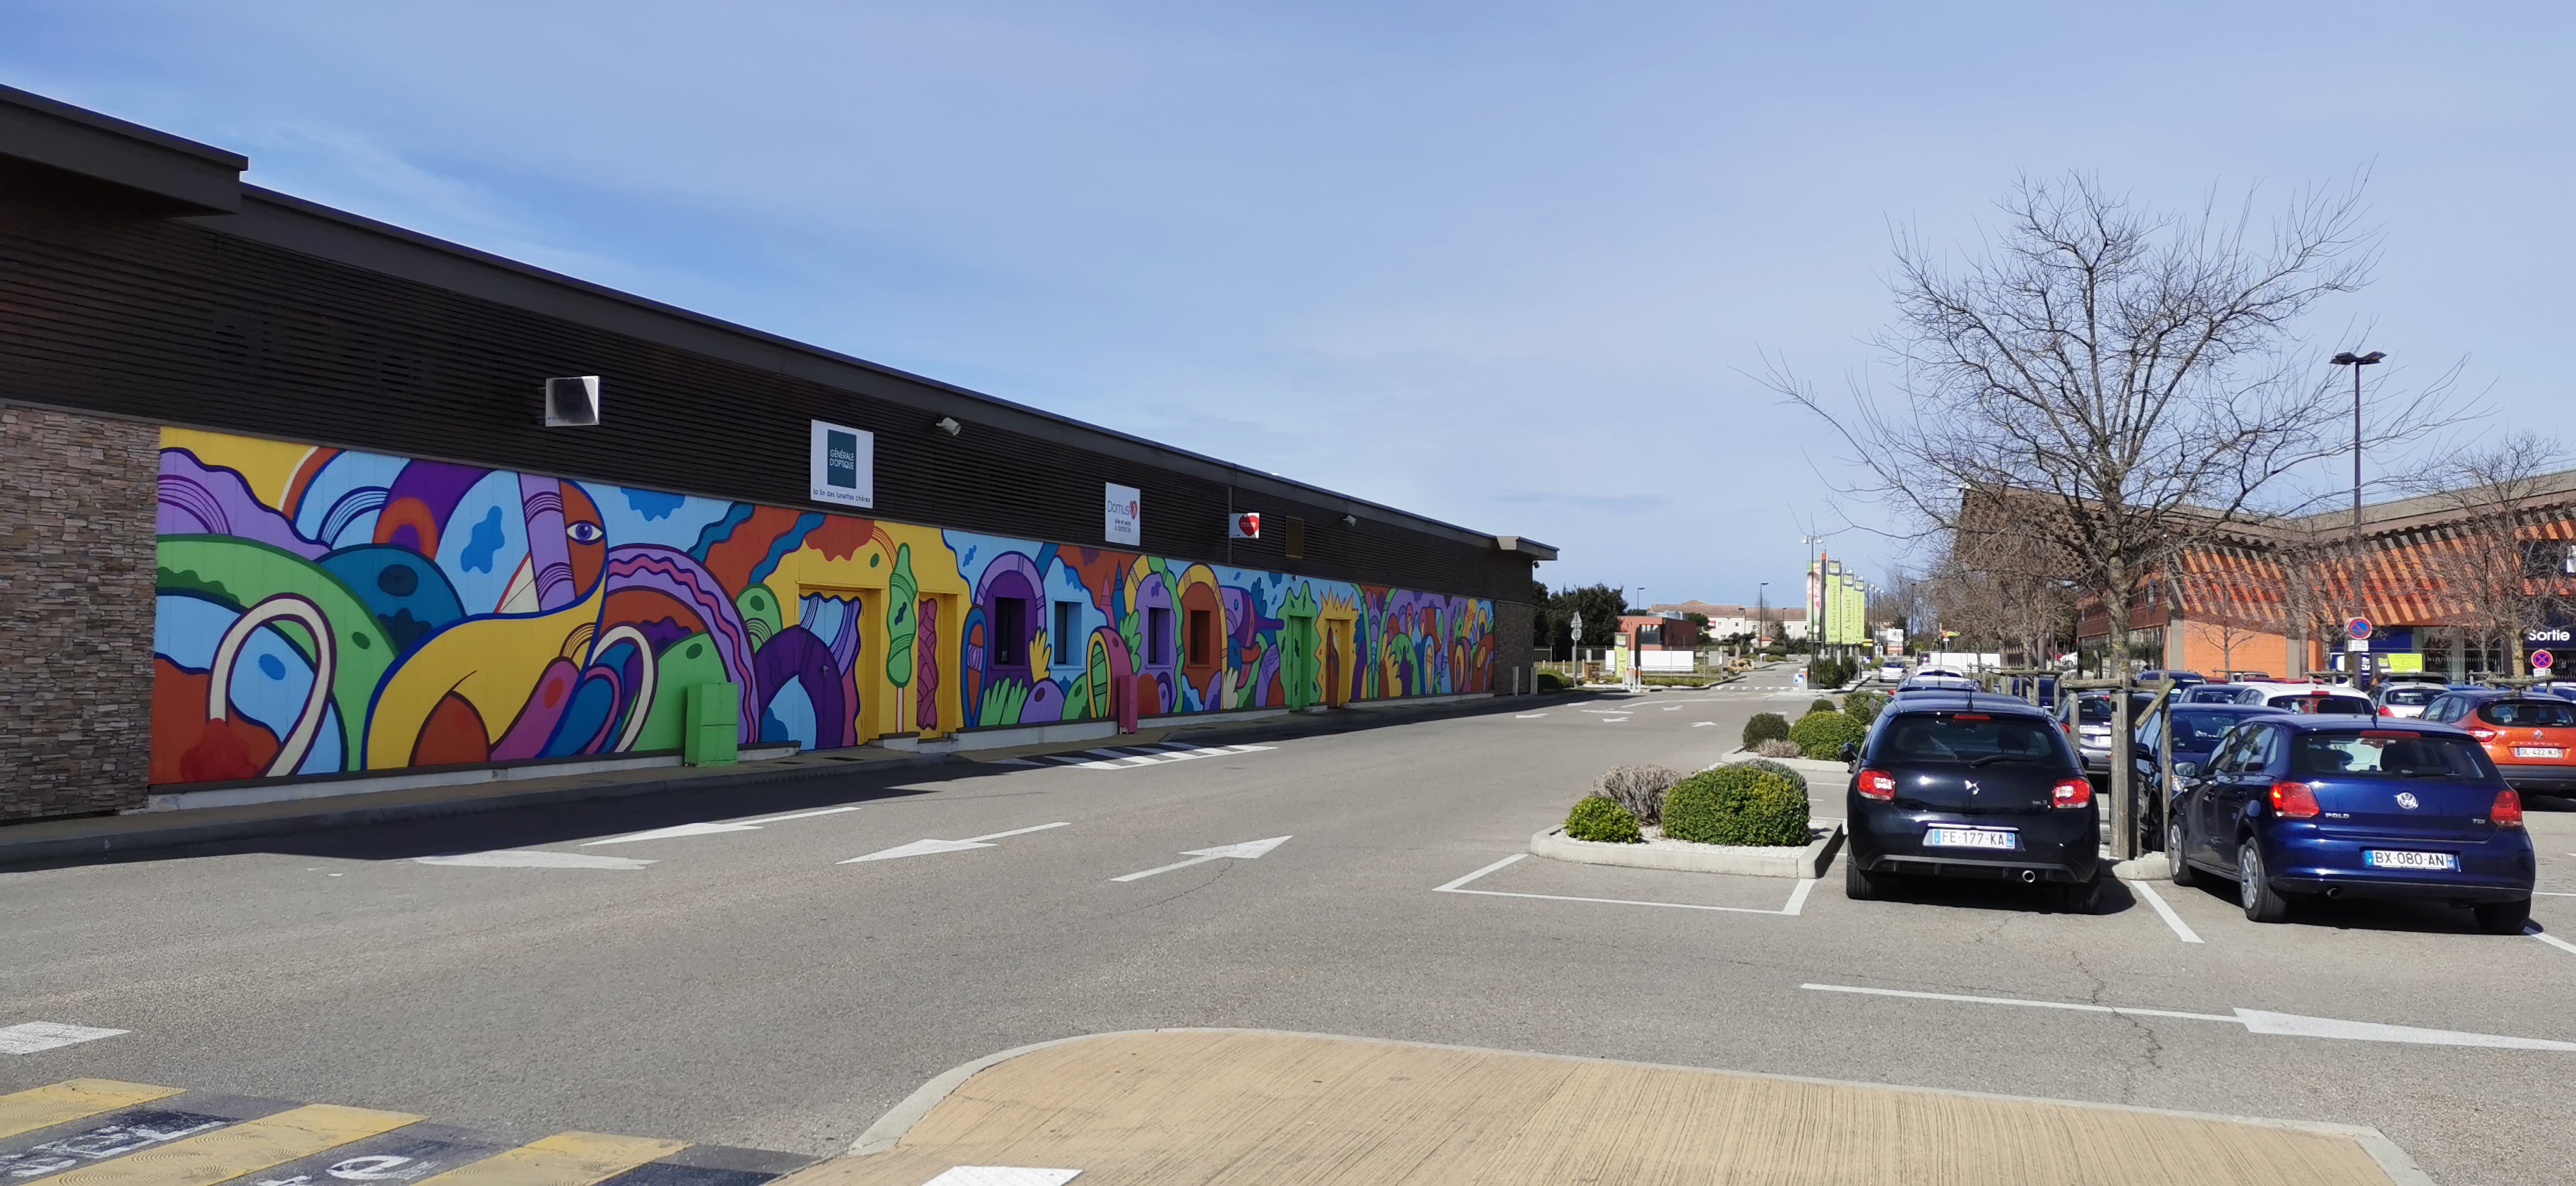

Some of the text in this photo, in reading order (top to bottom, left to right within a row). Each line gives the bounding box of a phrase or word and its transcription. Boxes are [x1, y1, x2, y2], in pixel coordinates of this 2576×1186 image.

[830, 448, 854, 461] GÉNÉRALE
[830, 457, 854, 470] D'OPTIQUE
[836, 491, 854, 501] lunettes
[1107, 500, 1130, 515] Domus
[2528, 629, 2570, 642] Sortie
[1942, 831, 2004, 846] FE-177-KA
[2375, 851, 2445, 867] BX-080-AN
